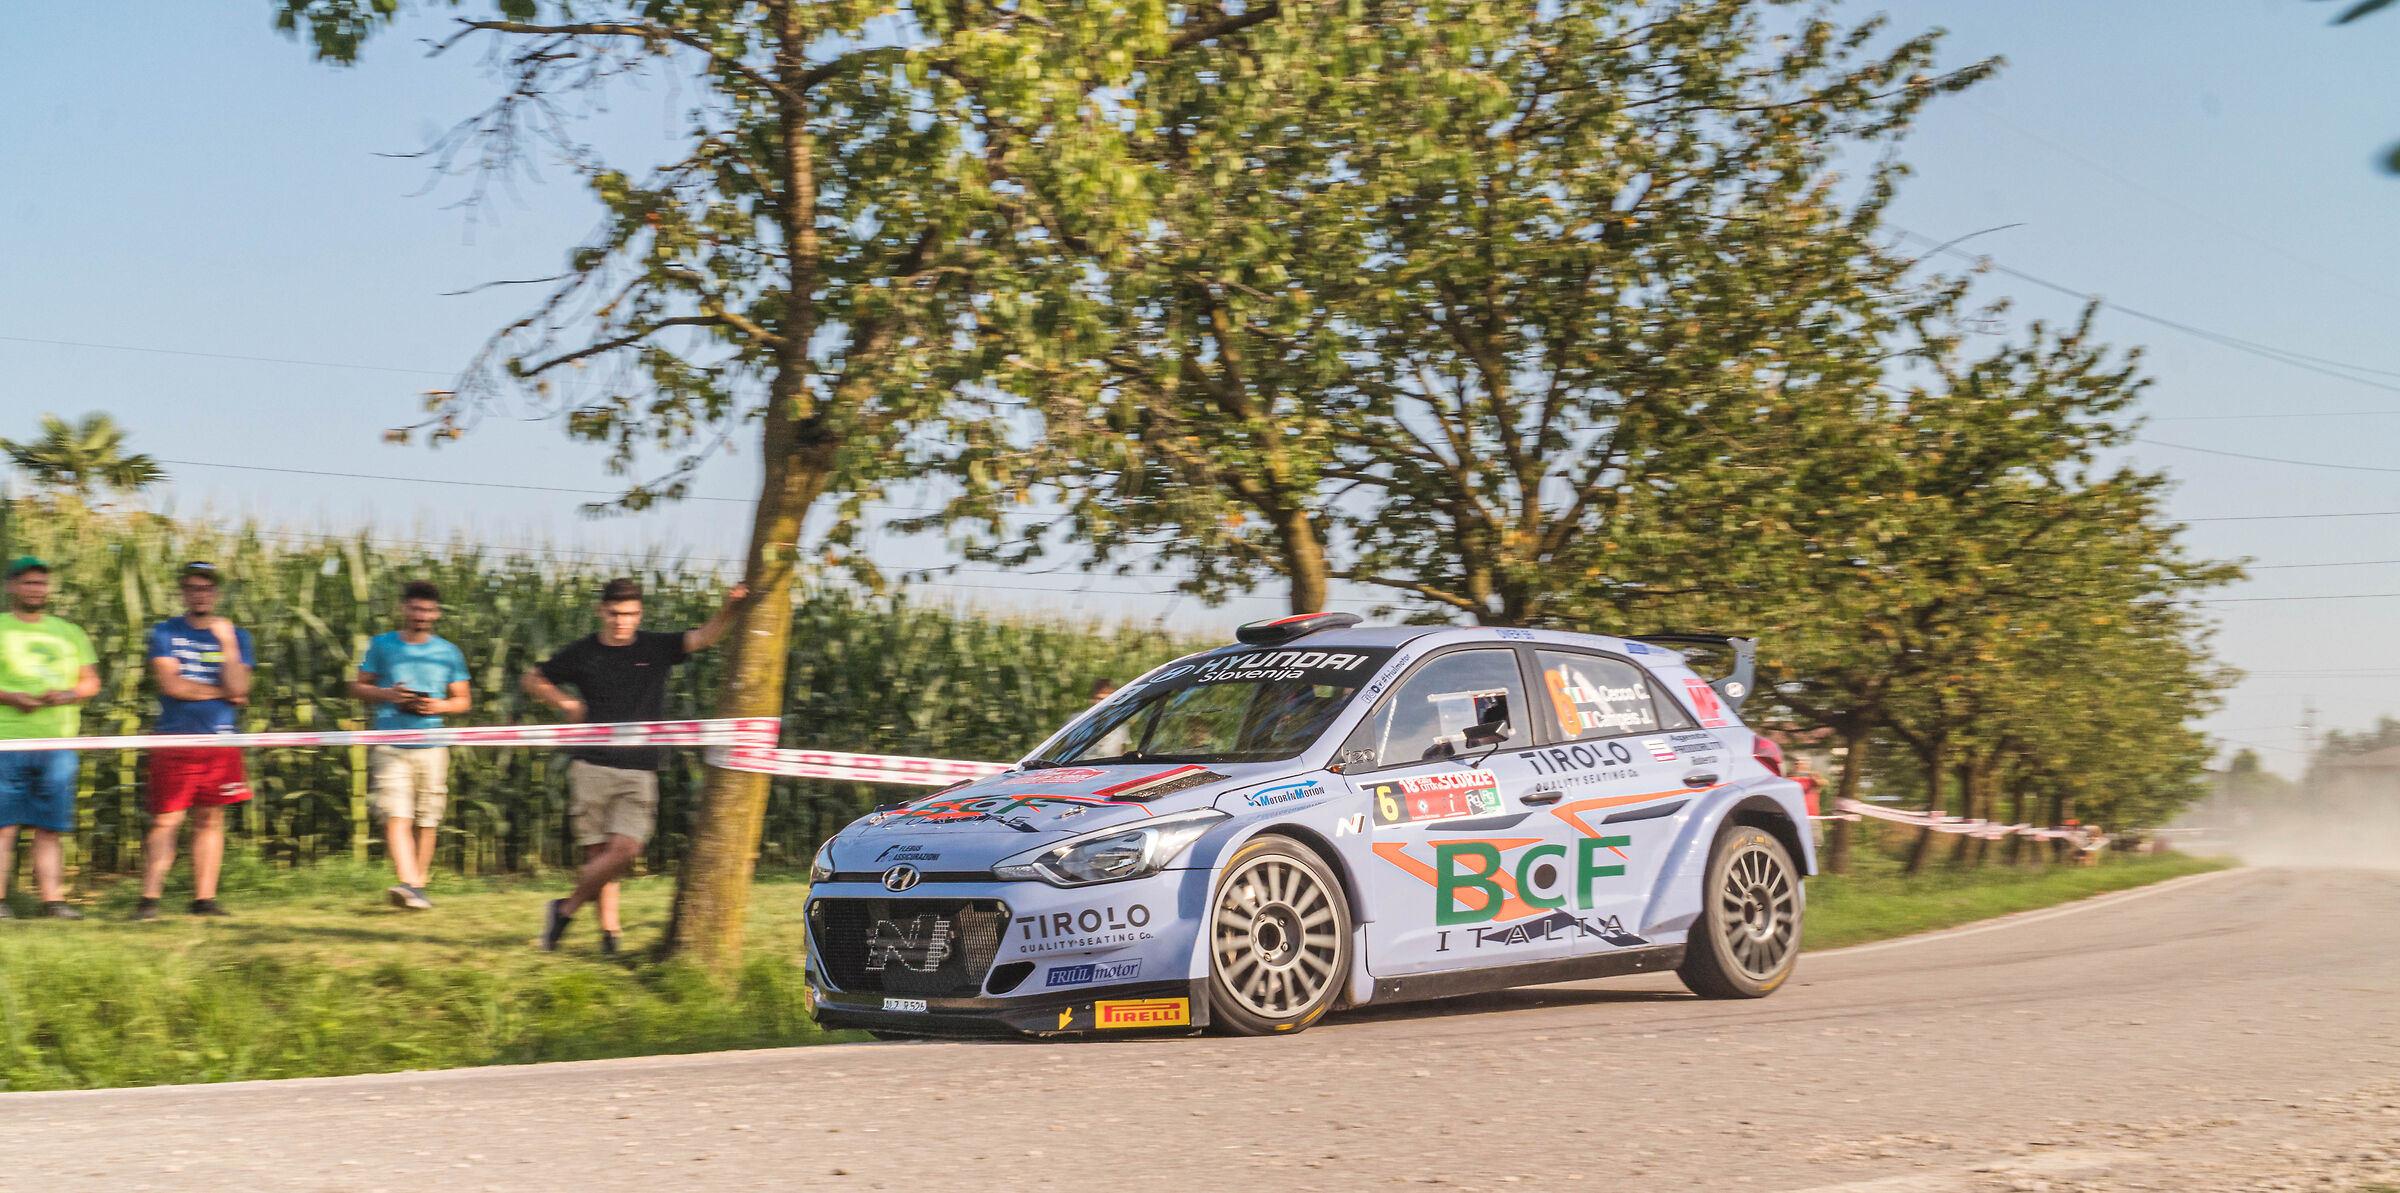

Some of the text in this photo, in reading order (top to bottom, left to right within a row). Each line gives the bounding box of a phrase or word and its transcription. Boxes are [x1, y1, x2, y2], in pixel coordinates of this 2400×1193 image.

[1194, 651, 1369, 675] HYUNDAI
[1198, 667, 1305, 683] Slovenija
[1544, 669, 1583, 736] 6
[1519, 741, 1631, 776] TIROLO
[1536, 777, 1580, 792] QUALITY
[1583, 770, 1626, 784] SEATING
[1376, 785, 1399, 822] 6
[1436, 835, 1631, 926] BCF
[1015, 904, 1151, 940] TIROLO
[1436, 914, 1629, 952] ITALIA
[1020, 939, 1074, 953] QUALITY
[1079, 932, 1135, 947] SEATING
[1104, 1002, 1180, 1023] PIRELLI
